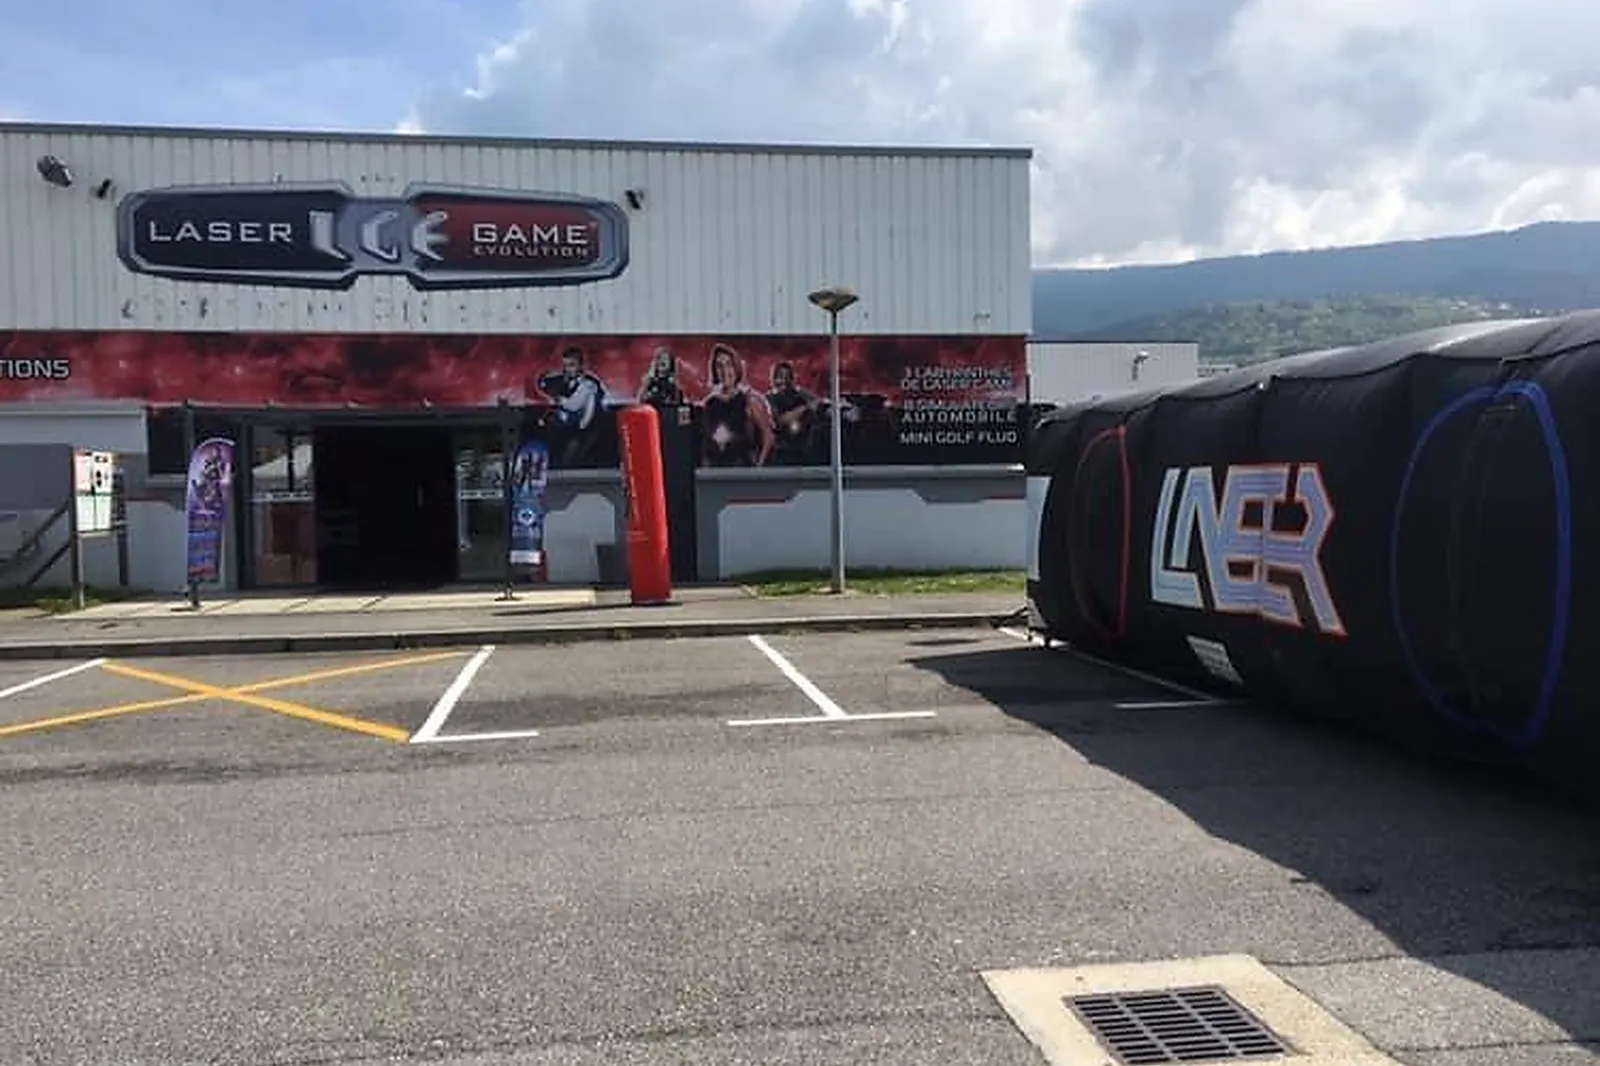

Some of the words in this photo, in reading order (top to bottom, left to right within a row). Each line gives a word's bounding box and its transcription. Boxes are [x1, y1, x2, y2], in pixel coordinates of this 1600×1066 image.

[149, 220, 293, 243] LASER
[472, 222, 589, 245] GAME
[472, 244, 590, 257] EVOLUTION
[901, 411, 1018, 423] AUTOMOBILE
[900, 431, 933, 444] MINI
[935, 431, 975, 444] GOLF
[977, 431, 1018, 444] FLUO
